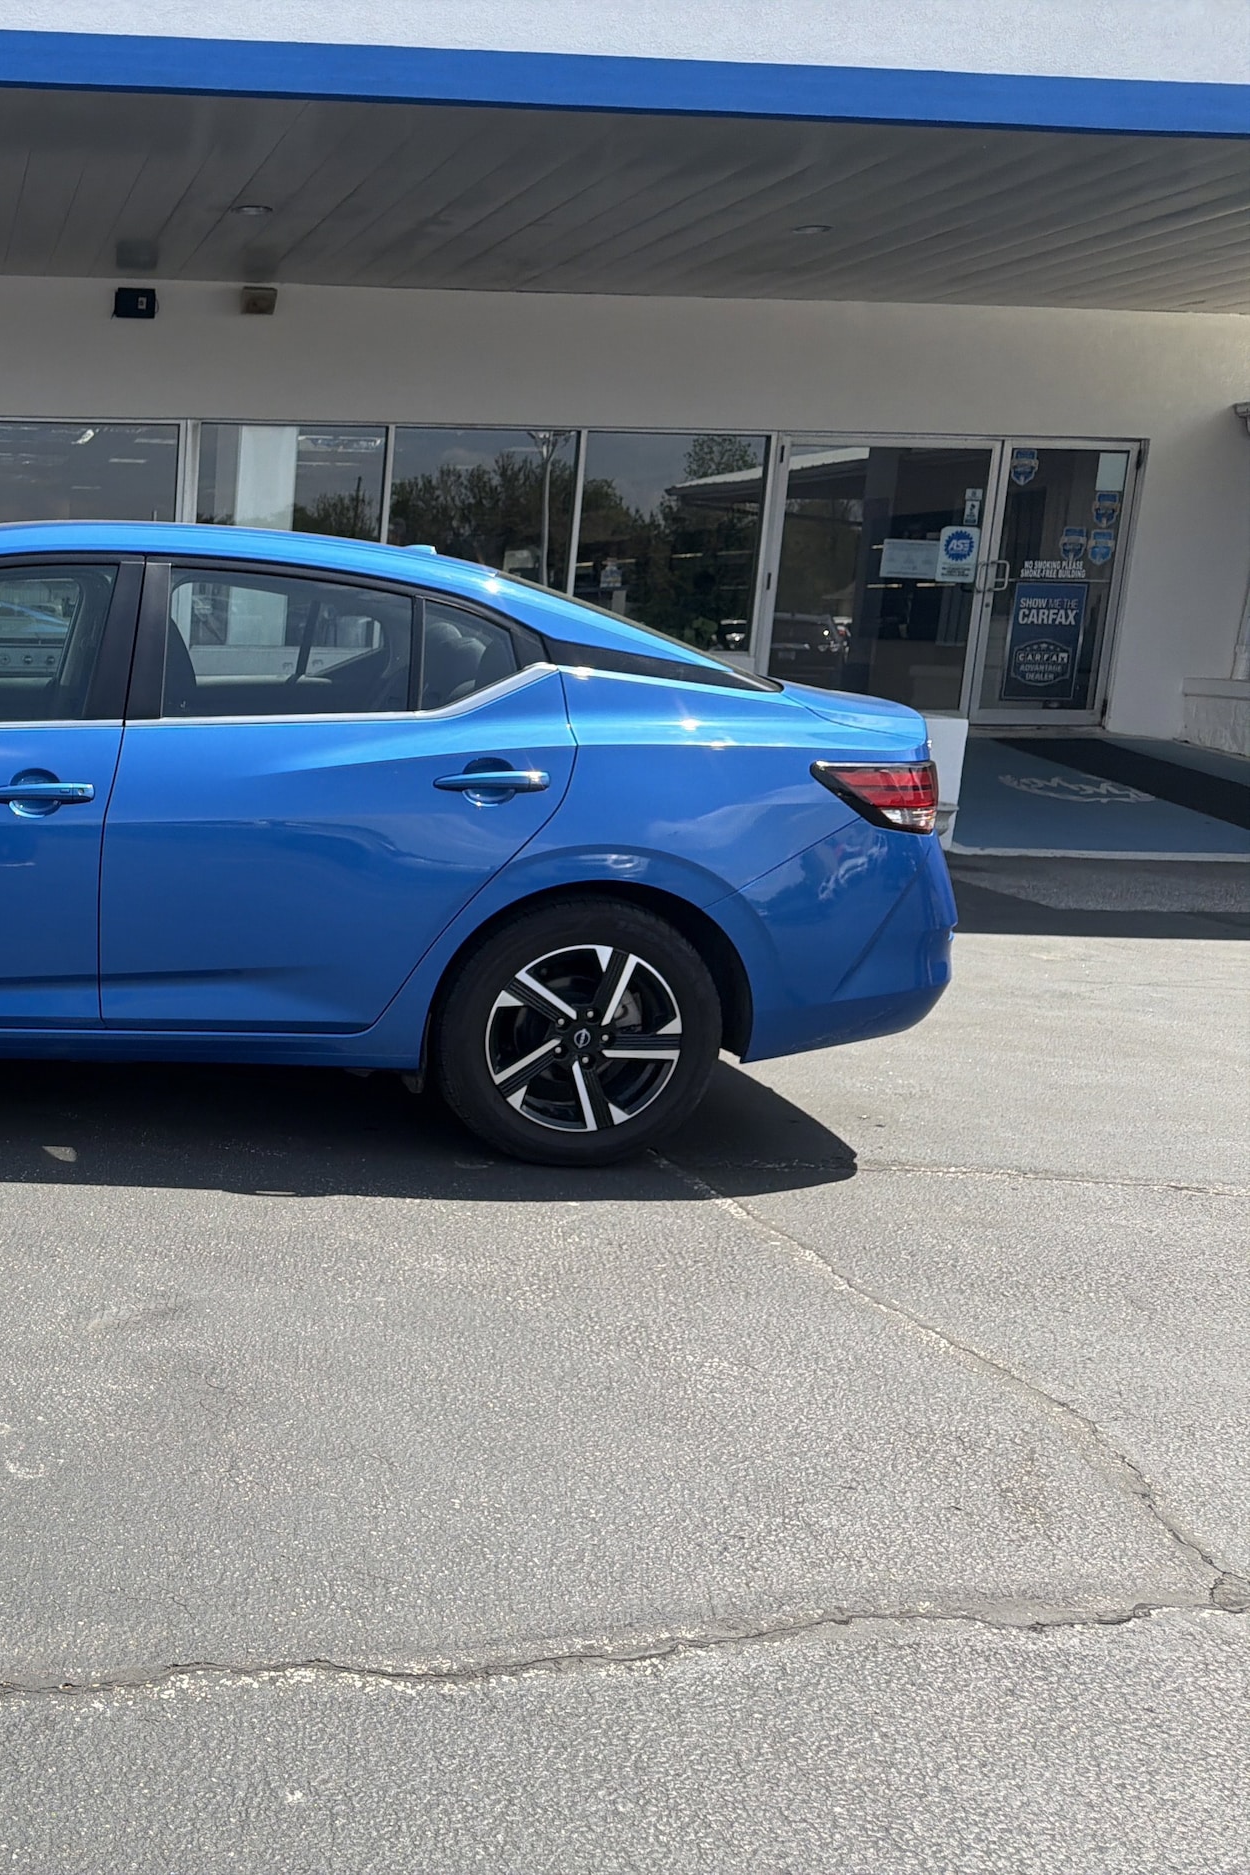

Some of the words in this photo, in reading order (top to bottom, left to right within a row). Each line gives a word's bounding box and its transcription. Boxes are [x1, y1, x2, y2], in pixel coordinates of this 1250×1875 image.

[1024, 560, 1034, 569] NO
[1034, 560, 1061, 569] SMOKING
[1062, 560, 1084, 569] PLEASE
[1020, 569, 1057, 578] SMOKE-FREE
[1058, 569, 1086, 578] BUILDING
[1019, 597, 1048, 608] SHOW
[1048, 598, 1062, 609] ME
[1063, 598, 1079, 609] THE
[1018, 608, 1077, 625] CARFAX
[1018, 652, 1068, 663] CARFAX
[1025, 672, 1054, 681] DEALER
